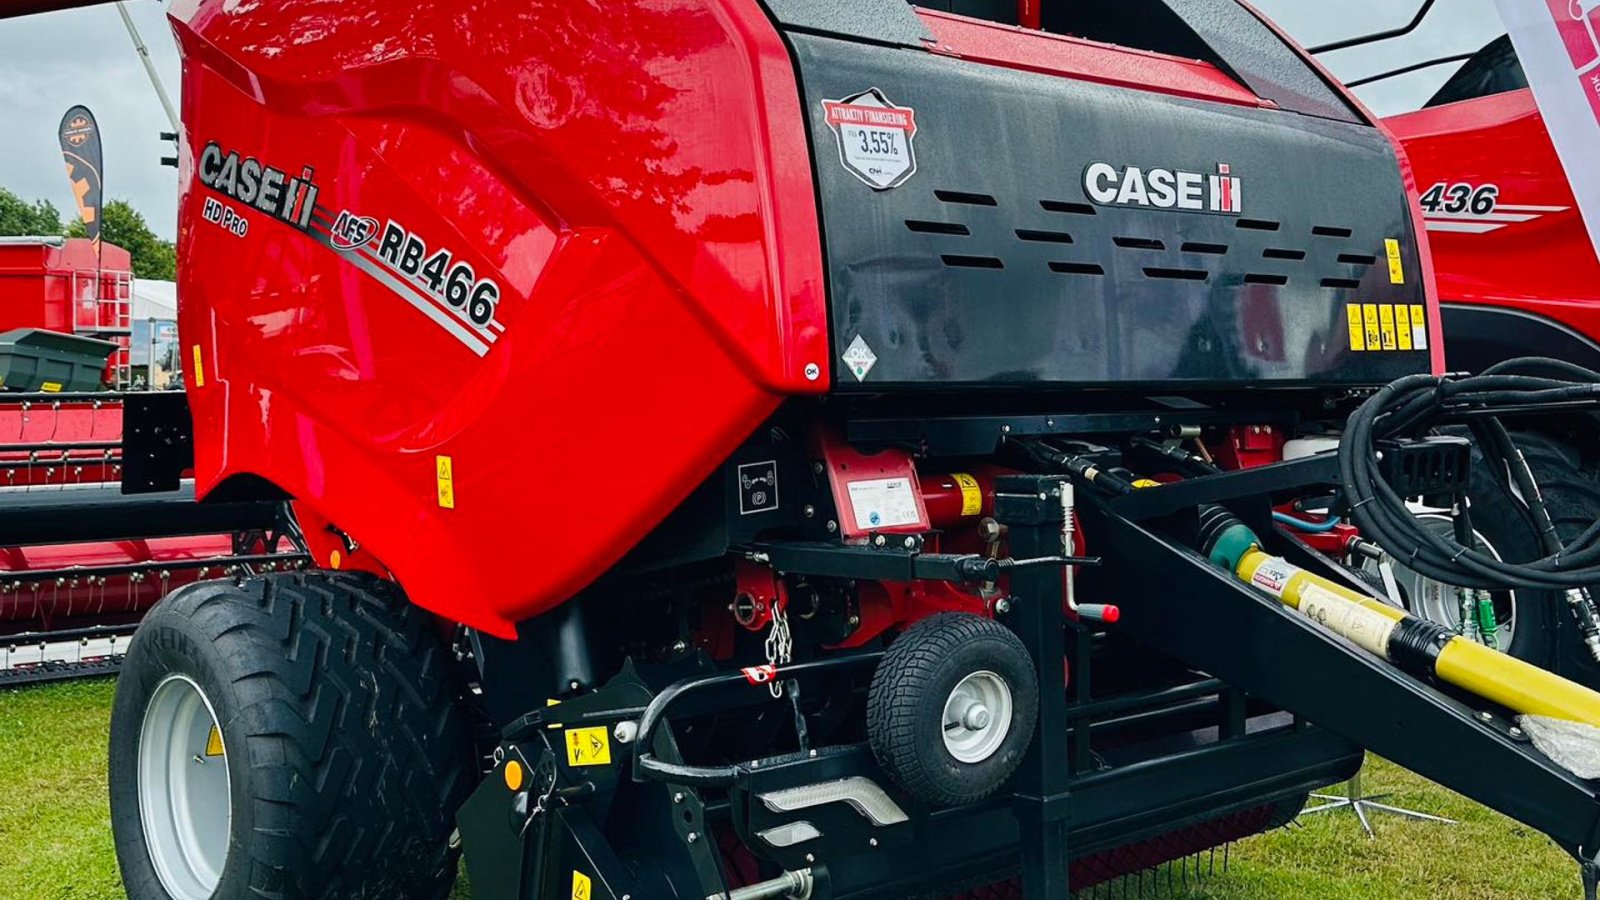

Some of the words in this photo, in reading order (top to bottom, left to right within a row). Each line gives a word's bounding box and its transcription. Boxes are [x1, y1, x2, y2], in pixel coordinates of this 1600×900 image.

[831, 106, 864, 122] ATTRAKTIV
[859, 130, 899, 155] 3,55%
[199, 142, 284, 212] CASE
[1084, 161, 1203, 209] CASE
[203, 197, 223, 222] HD
[1420, 182, 1498, 215] 436
[330, 209, 370, 245] AFS
[378, 219, 500, 329] RB466
[806, 368, 817, 376] OK
